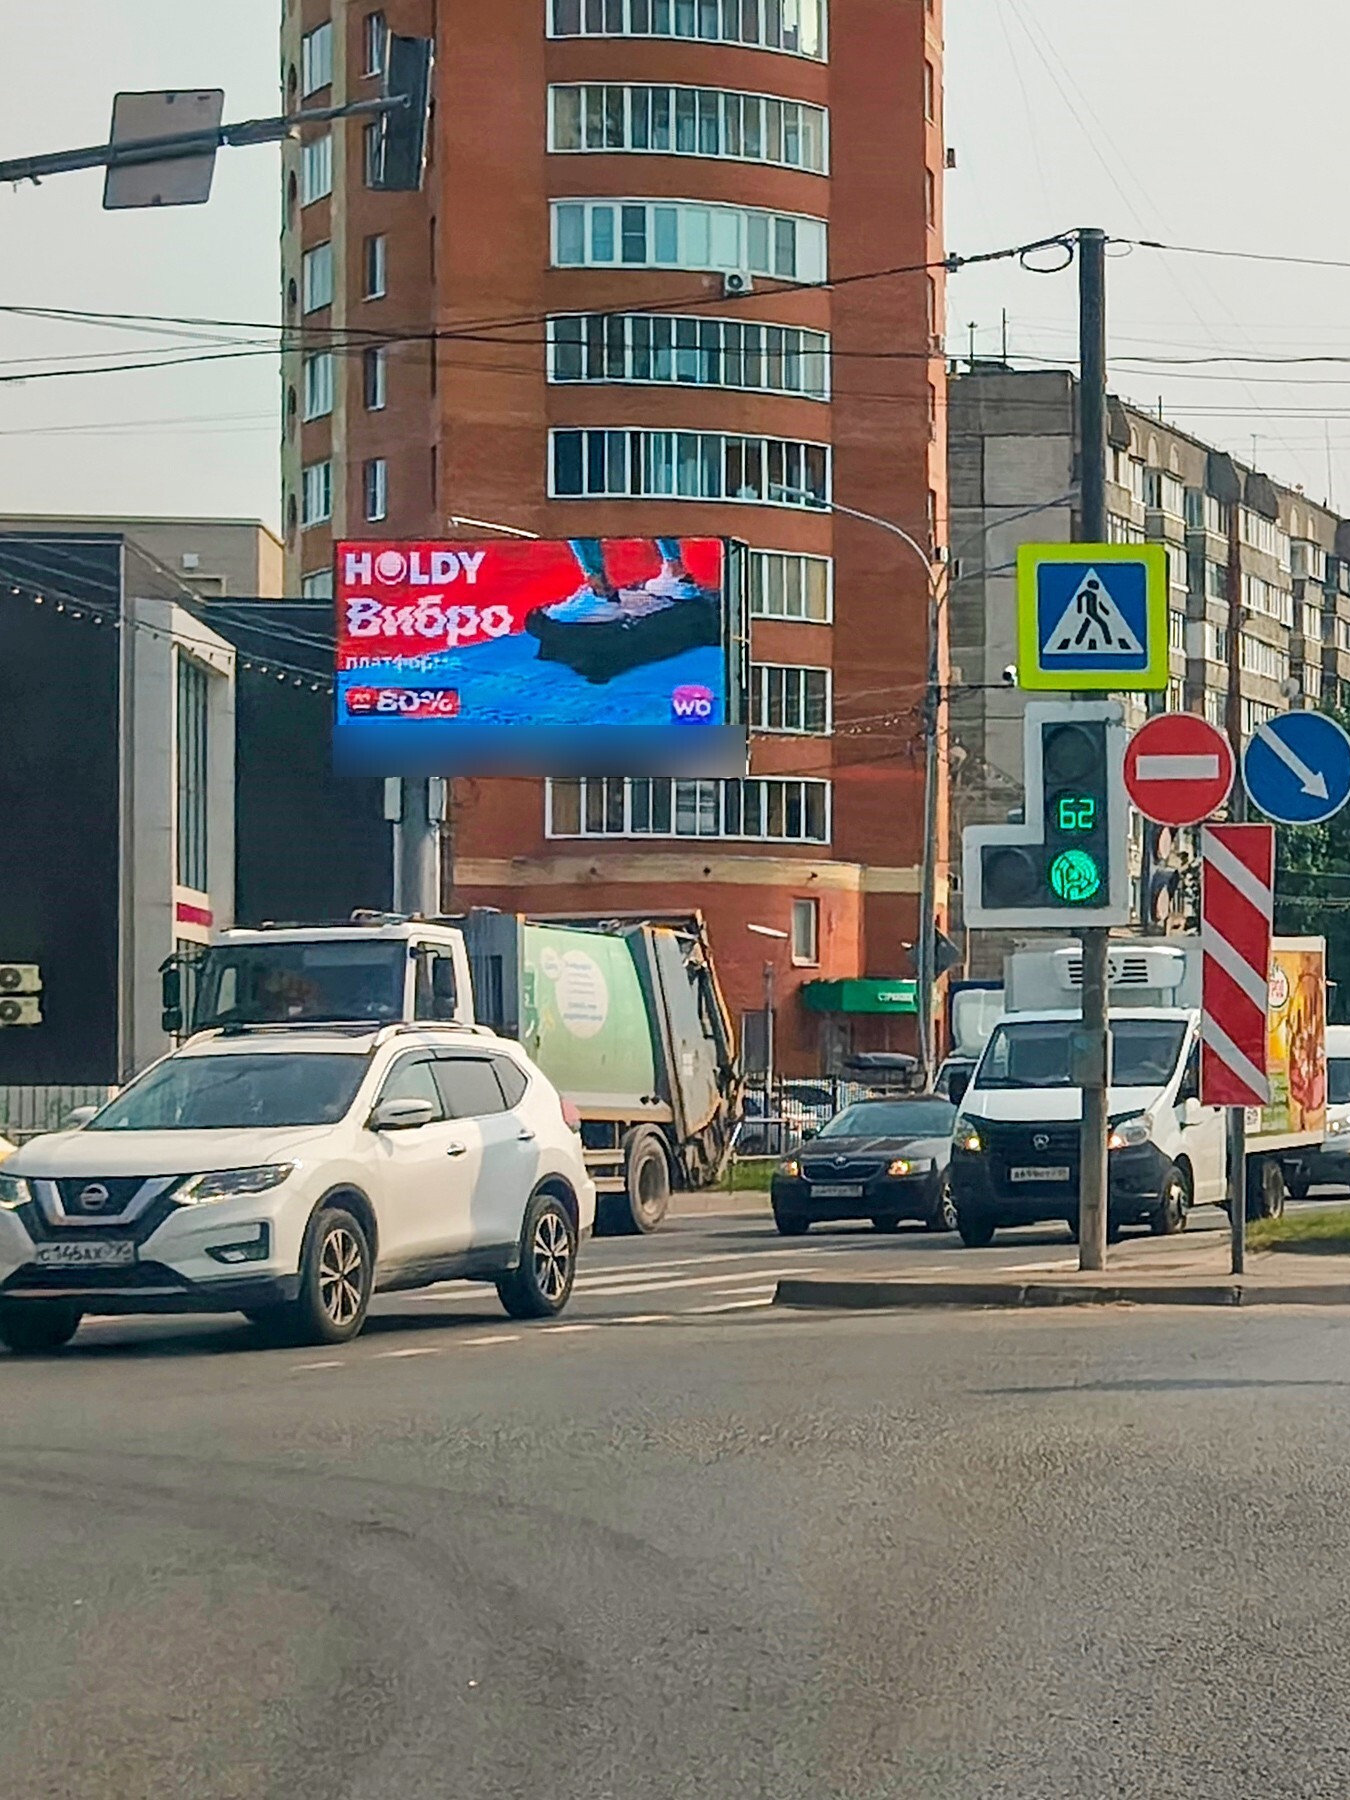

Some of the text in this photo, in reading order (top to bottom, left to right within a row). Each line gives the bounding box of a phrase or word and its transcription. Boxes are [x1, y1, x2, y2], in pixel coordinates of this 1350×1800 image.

[345, 550, 486, 585] HOLDY
[345, 594, 514, 646] Вибро
[1060, 799, 1094, 829] 62
